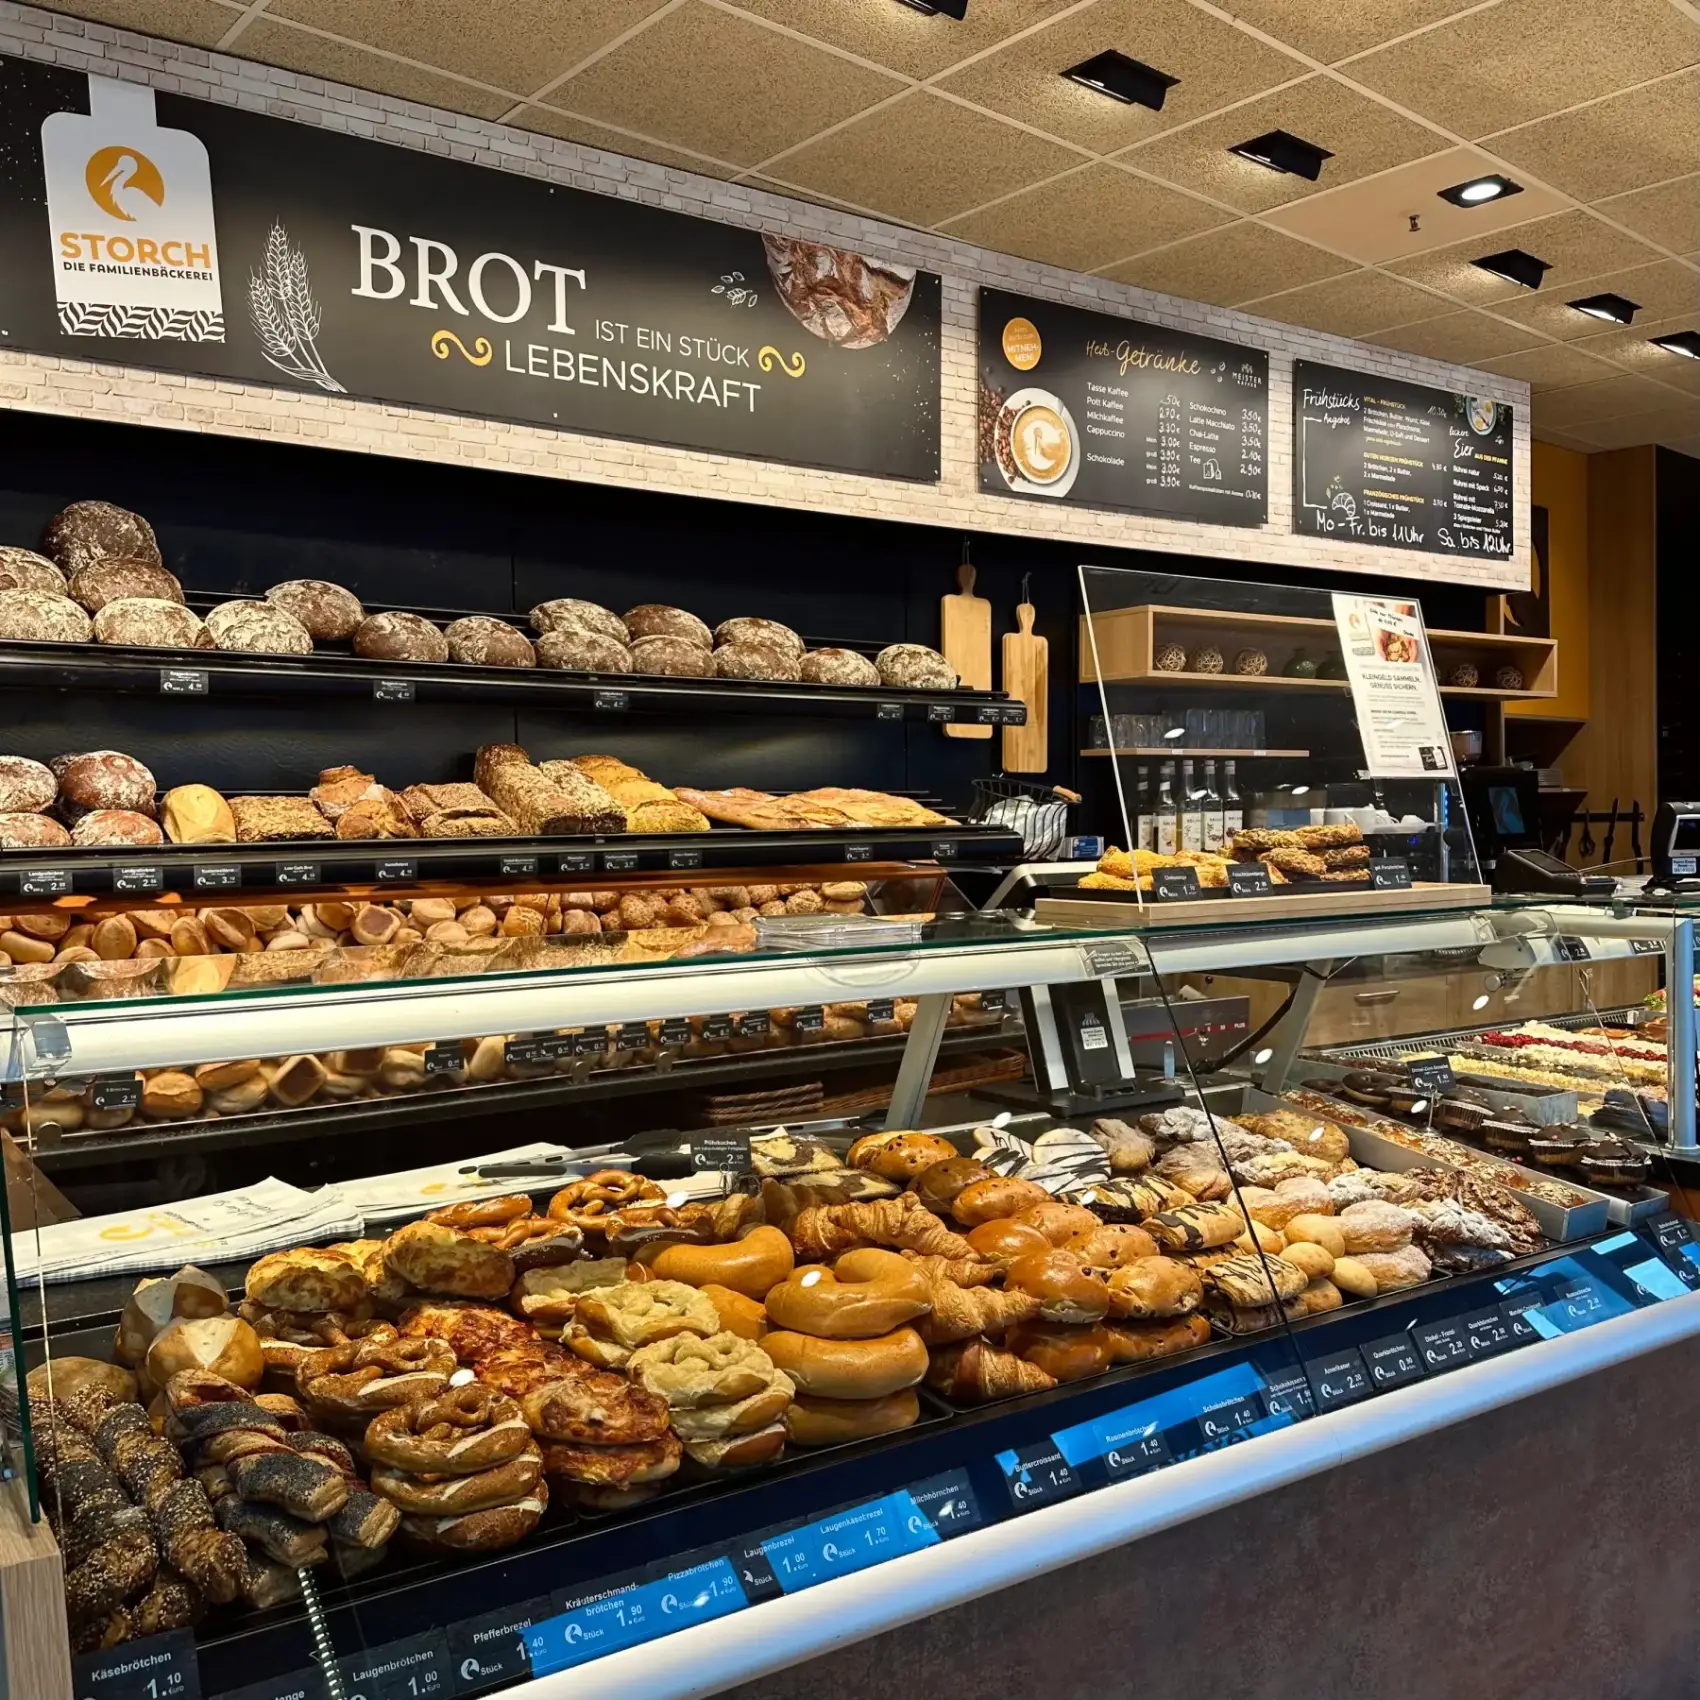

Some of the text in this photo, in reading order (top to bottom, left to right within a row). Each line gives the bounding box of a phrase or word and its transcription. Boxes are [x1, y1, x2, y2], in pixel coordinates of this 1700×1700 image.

[60, 232, 211, 269] STORCH
[63, 261, 213, 281] DIE FAMILIENBÄCKEREI
[351, 224, 587, 336] BROT
[595, 319, 751, 369] IST EIN STÜCK
[505, 339, 762, 413] LEBENSKRAFT
[1232, 372, 1262, 385] MEISTER
[1087, 381, 1129, 398] Tasse Kaffee
[1087, 396, 1124, 410] Pott Kaffee
[1303, 387, 1361, 412] Frühstücks
[1087, 410, 1124, 424] Milchkaffee
[1189, 402, 1227, 416] Schokochino
[1087, 425, 1125, 438] Cappuccino
[1189, 416, 1204, 425] Latte
[1206, 418, 1235, 431] Macchiato
[1189, 442, 1216, 453] Espresso
[1453, 438, 1475, 459] Eier
[1087, 453, 1125, 466] Schokolade
[1189, 455, 1201, 464] Tee
[1368, 518, 1388, 538] bis
[1460, 531, 1480, 550] bis
[1324, 1362, 1351, 1375] Amerikaner
[1202, 1395, 1245, 1413] Schokobrötchen
[1216, 1426, 1230, 1434] Stück
[1014, 1452, 1062, 1472] Buttercroissant
[1121, 1456, 1135, 1465] Stück
[910, 1485, 959, 1506] Milchhörnchen
[1028, 1486, 1043, 1496] Stück
[743, 1535, 795, 1559] Laugenbrezel
[838, 1547, 857, 1558] Stück
[667, 1558, 725, 1582] Pizzabrötchen
[754, 1574, 773, 1586] Stück
[565, 1581, 640, 1610] Kräuterschmand-
[585, 1599, 625, 1617] brötchen
[472, 1617, 532, 1644] Pfefferbrezel
[583, 1628, 605, 1641] Stück
[91, 1652, 172, 1682] Käsebrötchen
[352, 1650, 434, 1682] Laugenbrötchen
[480, 1662, 504, 1676] Stück
[168, 1685, 185, 1695] Euro
[426, 1682, 441, 1692] Euro
